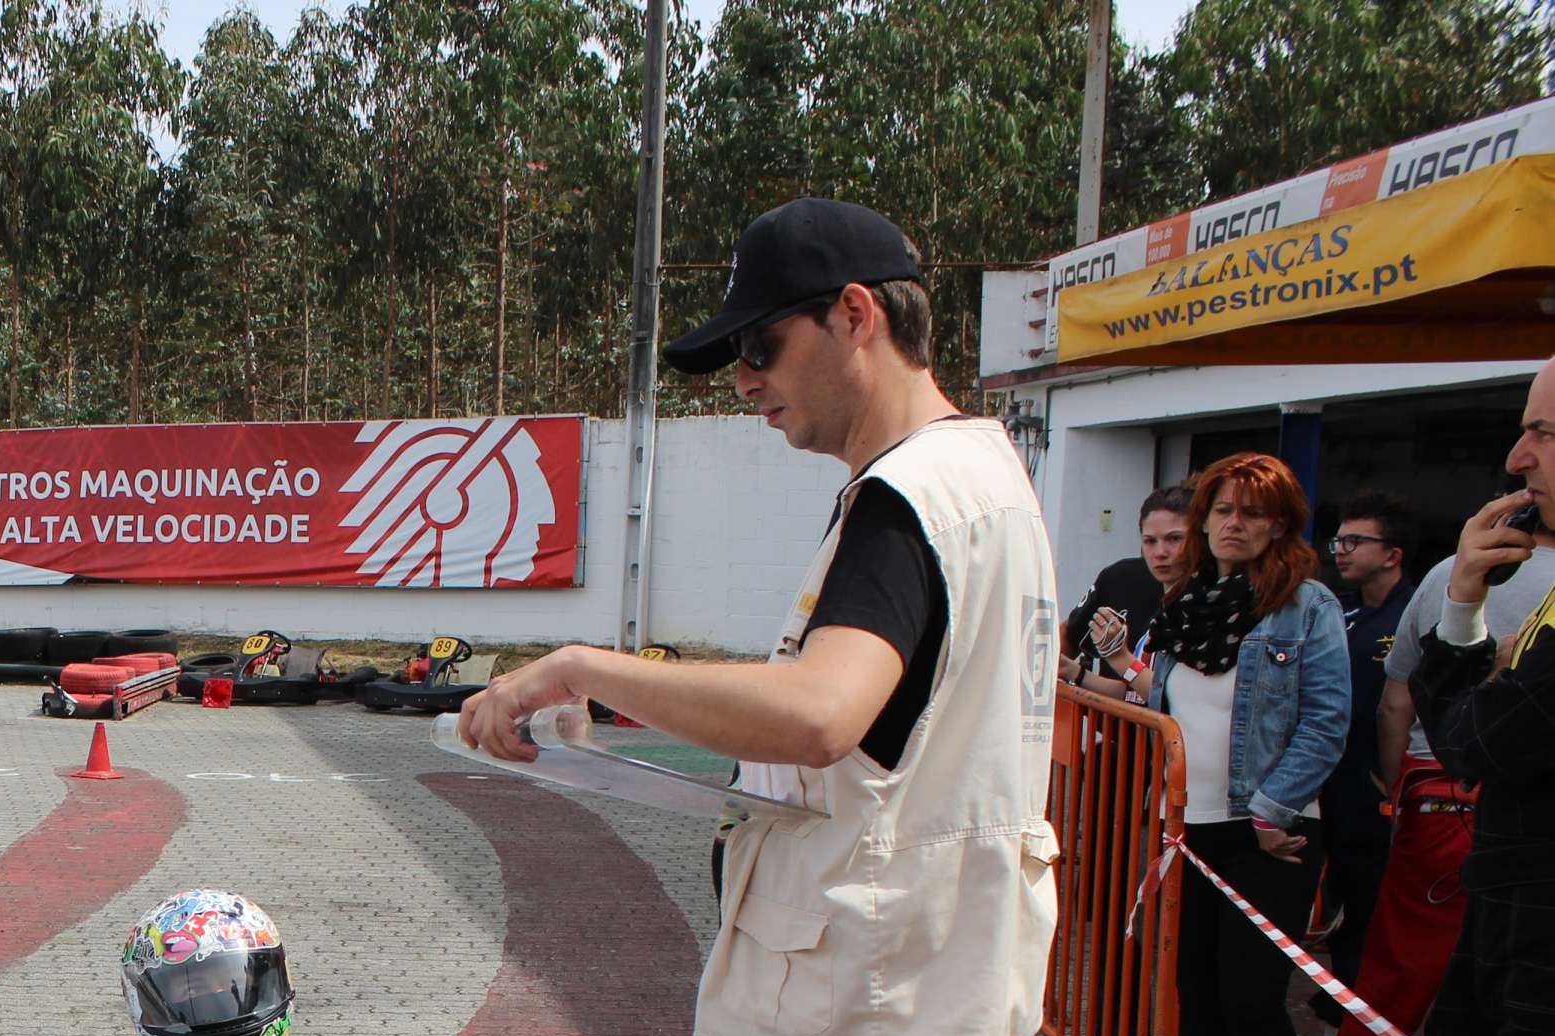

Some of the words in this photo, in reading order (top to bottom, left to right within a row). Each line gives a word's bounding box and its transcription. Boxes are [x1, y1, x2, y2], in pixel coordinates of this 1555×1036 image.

[1104, 254, 1418, 339] www.pestronix.pt
[79, 459, 321, 504] MAQUINAÇÃO
[0, 515, 82, 544] ALTA
[90, 513, 310, 543] VELOCIDADE
